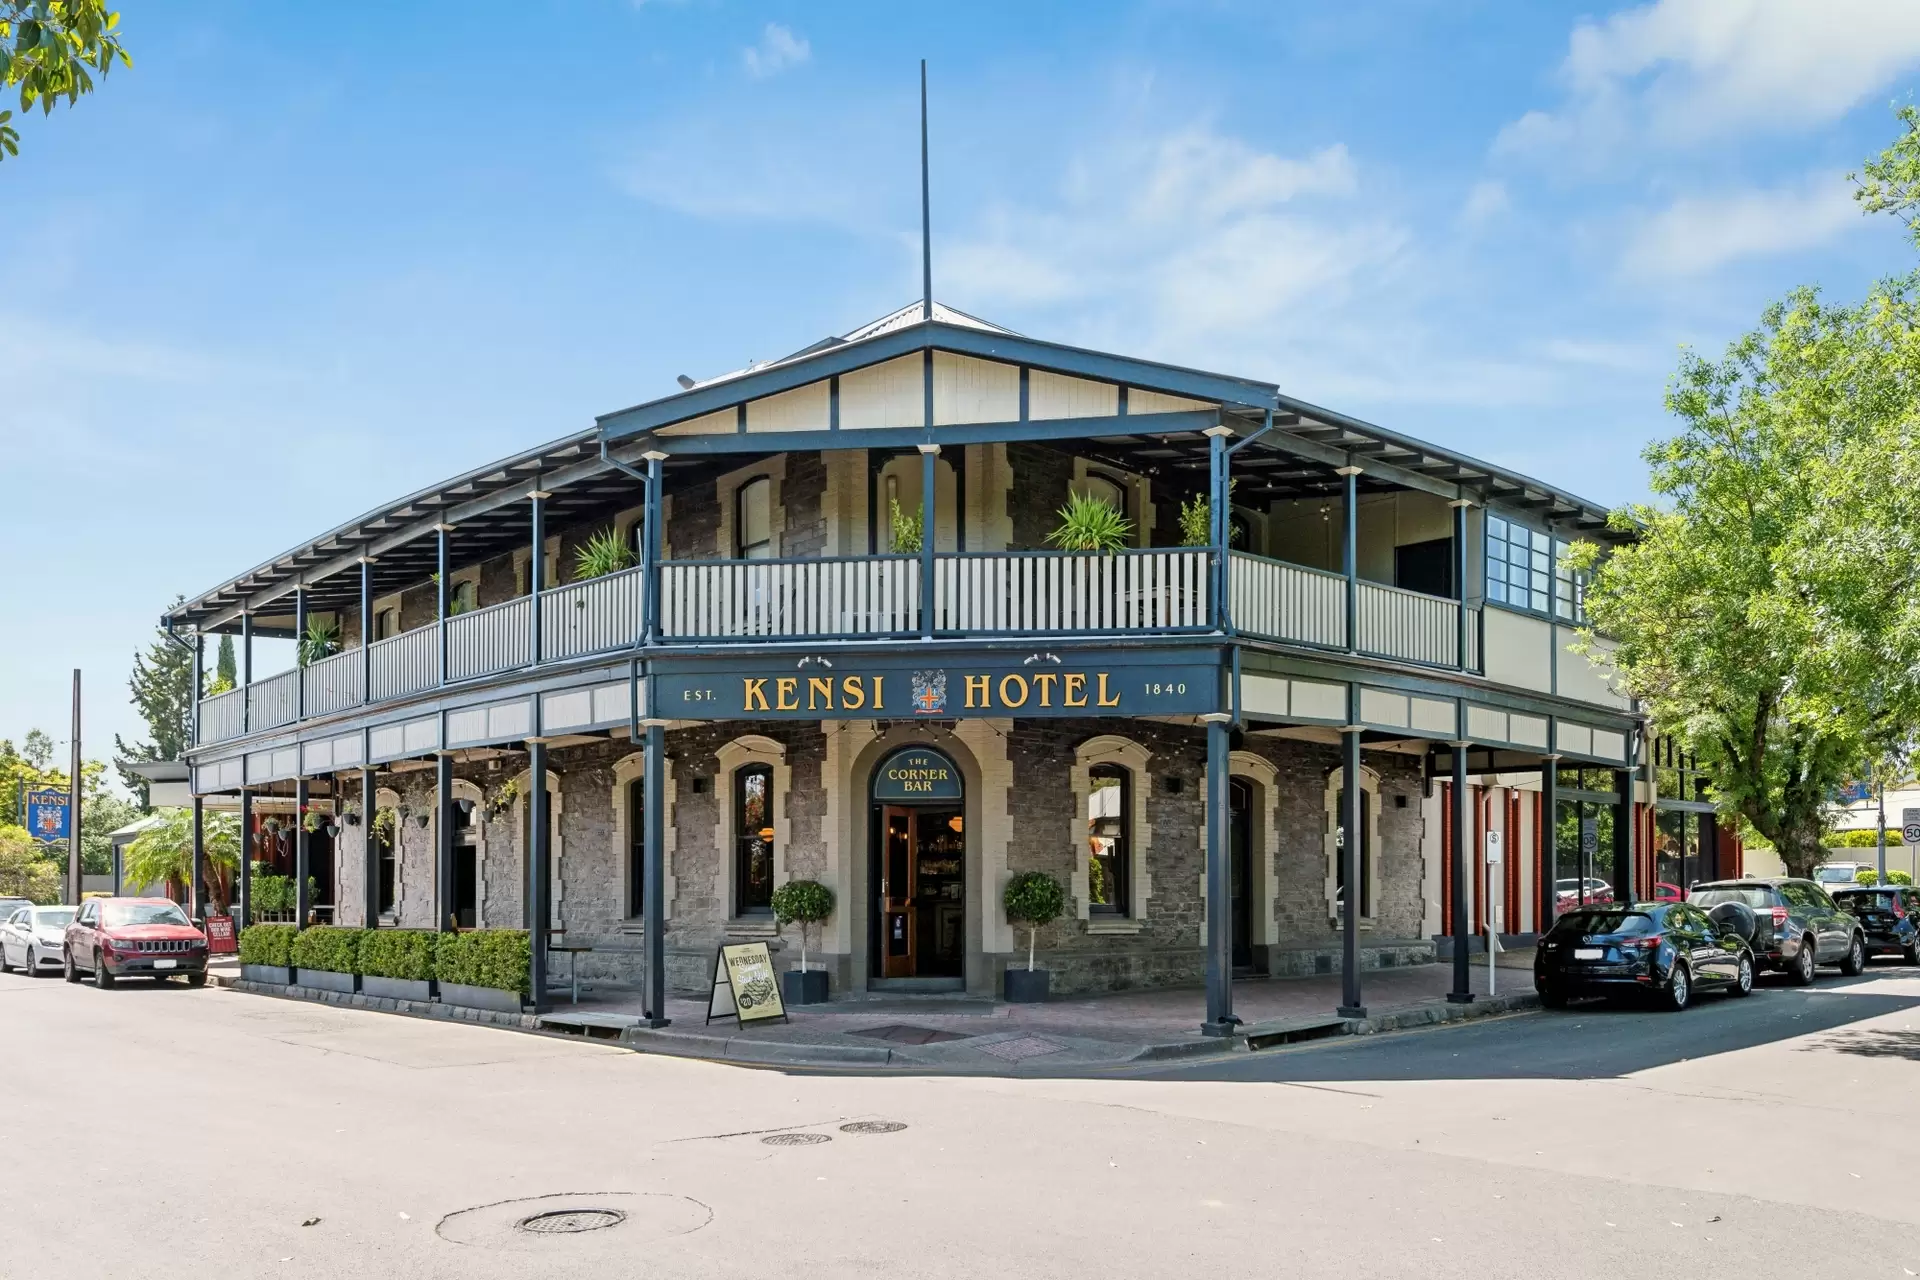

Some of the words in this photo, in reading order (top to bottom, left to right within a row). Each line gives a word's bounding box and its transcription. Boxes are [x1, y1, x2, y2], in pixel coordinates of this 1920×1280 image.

[684, 690, 717, 701] EST.
[743, 676, 884, 711] KENSI
[964, 672, 1121, 708] HOTEL
[1144, 683, 1186, 695] 1840
[908, 758, 929, 766] THE
[888, 769, 949, 780] CORNER
[904, 781, 933, 792] BAR
[31, 794, 69, 806] KENSI
[1906, 828, 1920, 838] 50
[729, 954, 767, 967] WEDNESDAY
